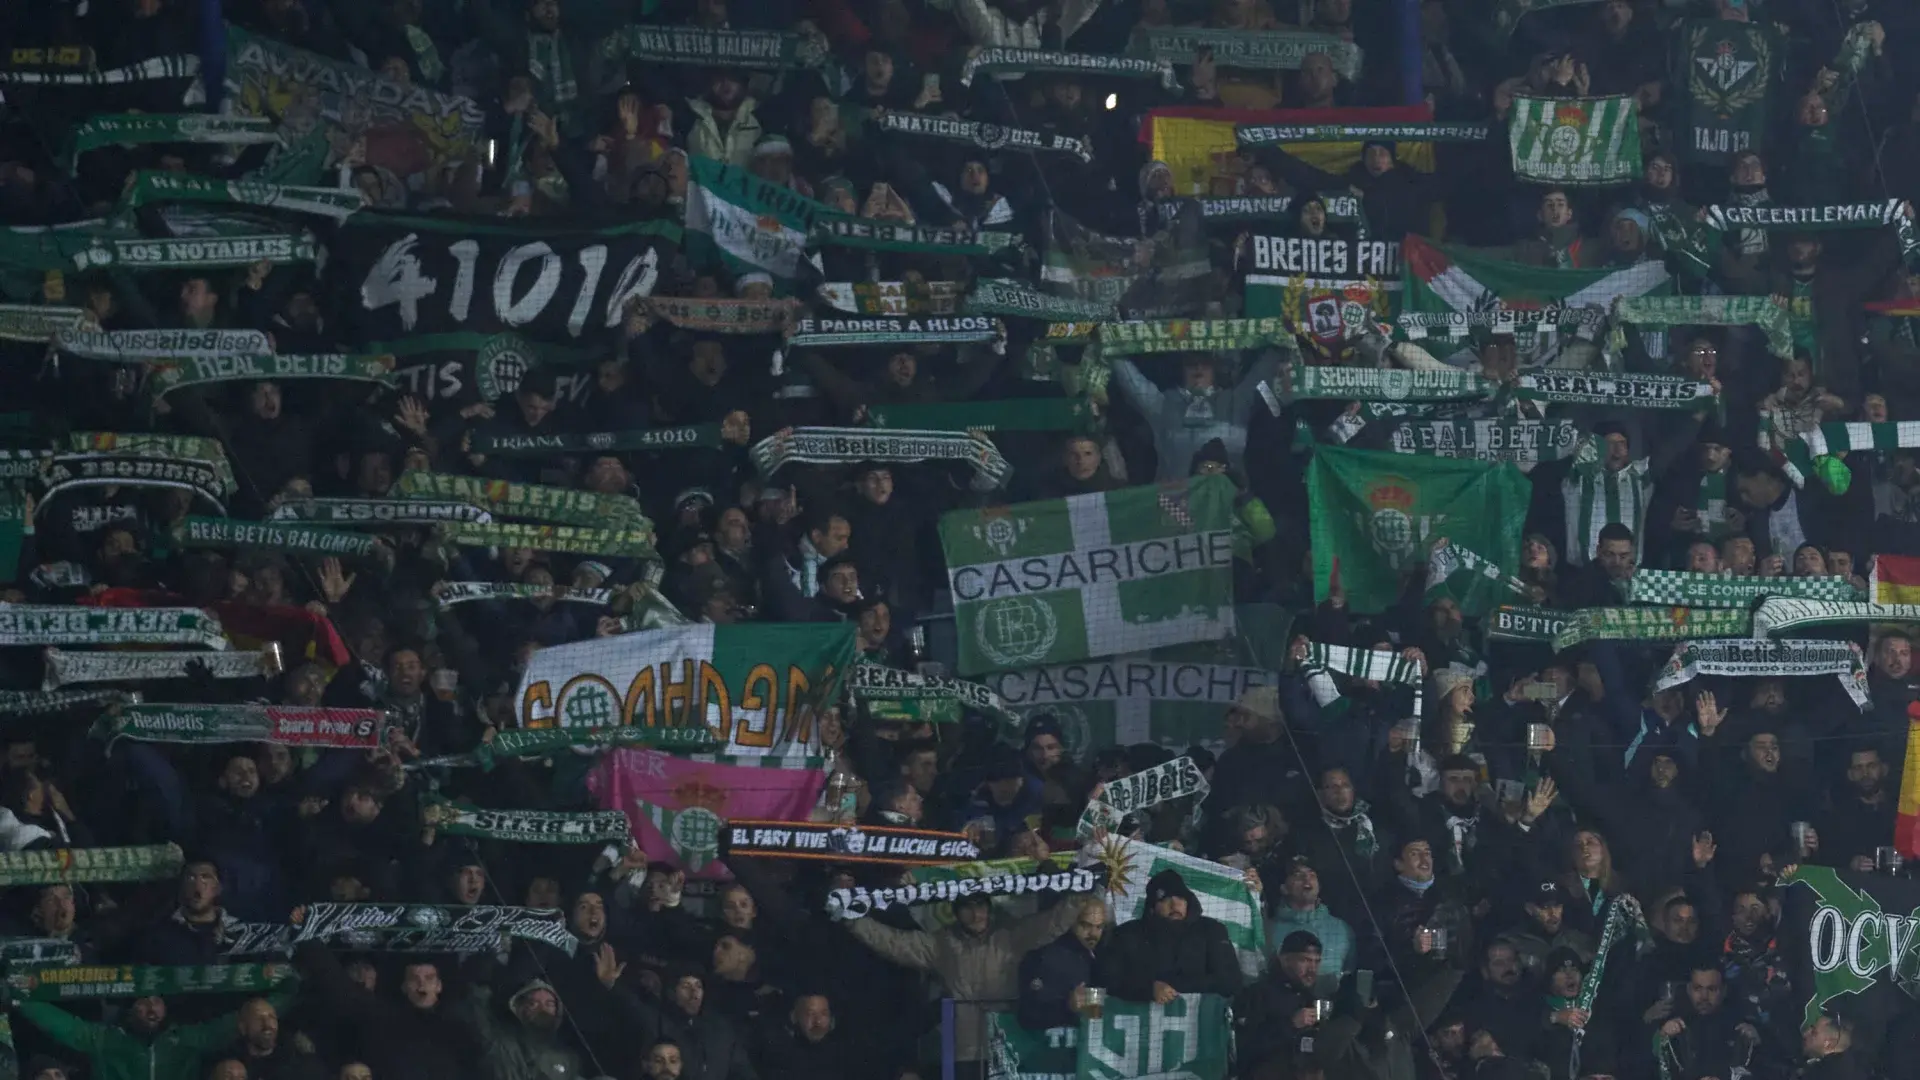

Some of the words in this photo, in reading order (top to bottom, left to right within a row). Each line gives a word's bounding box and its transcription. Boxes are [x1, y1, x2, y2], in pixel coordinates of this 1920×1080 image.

[1011, 129, 1042, 145] DEL
[1693, 127, 1729, 152] TAJO
[119, 244, 162, 260] LOS
[167, 239, 292, 259] NOTABLES
[1253, 236, 1348, 274] BRENES
[821, 319, 902, 333] PADRES
[907, 320, 922, 332] A
[927, 318, 987, 332] HIJOS
[1189, 318, 1277, 338] BETIS
[192, 354, 263, 380] REAL
[274, 353, 348, 373] BETIS
[1543, 369, 1583, 378] DICEN
[1533, 374, 1605, 397] REAL
[1614, 383, 1697, 401] BETIS
[1547, 394, 1588, 402] LOCOS
[1592, 397, 1605, 405] DE
[1612, 397, 1628, 406] LA
[1632, 398, 1680, 408] CABEZA
[642, 427, 697, 444] 41010
[1400, 426, 1475, 450] REAL
[1489, 424, 1575, 449] BETIS
[506, 485, 596, 513] BETIS
[190, 524, 229, 541] REAL
[234, 527, 284, 546] BETIS
[952, 531, 1231, 602] CASARICHE
[1685, 584, 1704, 595] SE
[1604, 608, 1673, 625] REAL
[855, 663, 918, 689] REAL
[131, 711, 204, 732] RealBetis
[1107, 760, 1199, 813] RealBetis
[732, 829, 749, 844] EL
[754, 830, 790, 846] FARY
[794, 832, 828, 848] VIVE
[867, 837, 888, 852] LA
[889, 838, 936, 856] LUCHA
[1540, 882, 1556, 891] CK
[1597, 894, 1619, 955] ESTAMO
